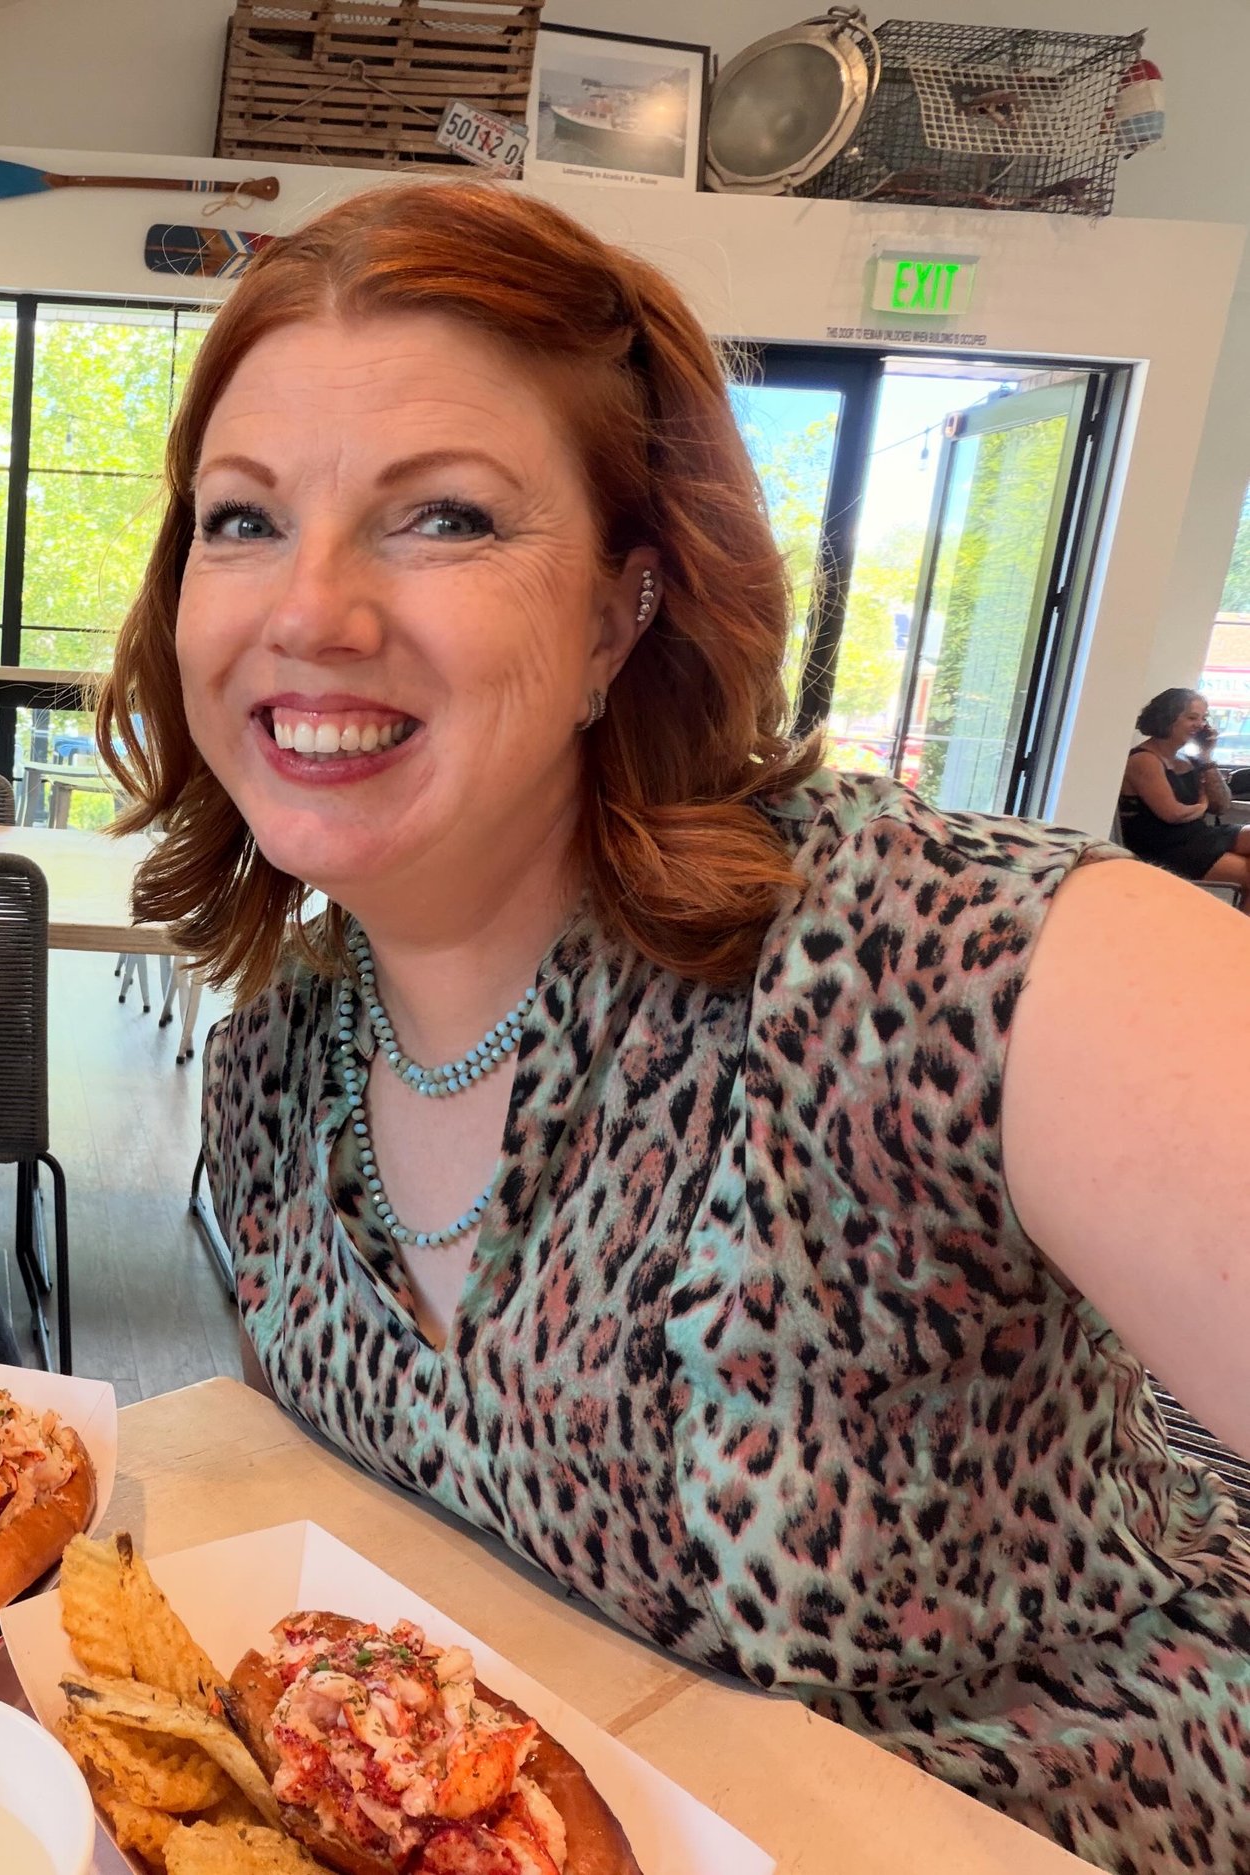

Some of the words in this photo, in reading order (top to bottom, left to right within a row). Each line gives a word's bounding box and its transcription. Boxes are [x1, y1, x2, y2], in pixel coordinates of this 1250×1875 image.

[473, 113, 507, 137] MAINE
[892, 261, 960, 310] EXIT
[826, 326, 838, 339] THIS
[838, 327, 854, 339] DOOR
[855, 328, 862, 340] TO
[863, 328, 882, 341] REMAIN
[883, 329, 911, 342] UNLOCKED
[913, 331, 928, 343] WHEN
[929, 332, 953, 344] BUILDING
[960, 334, 988, 346] OCCUPIED
